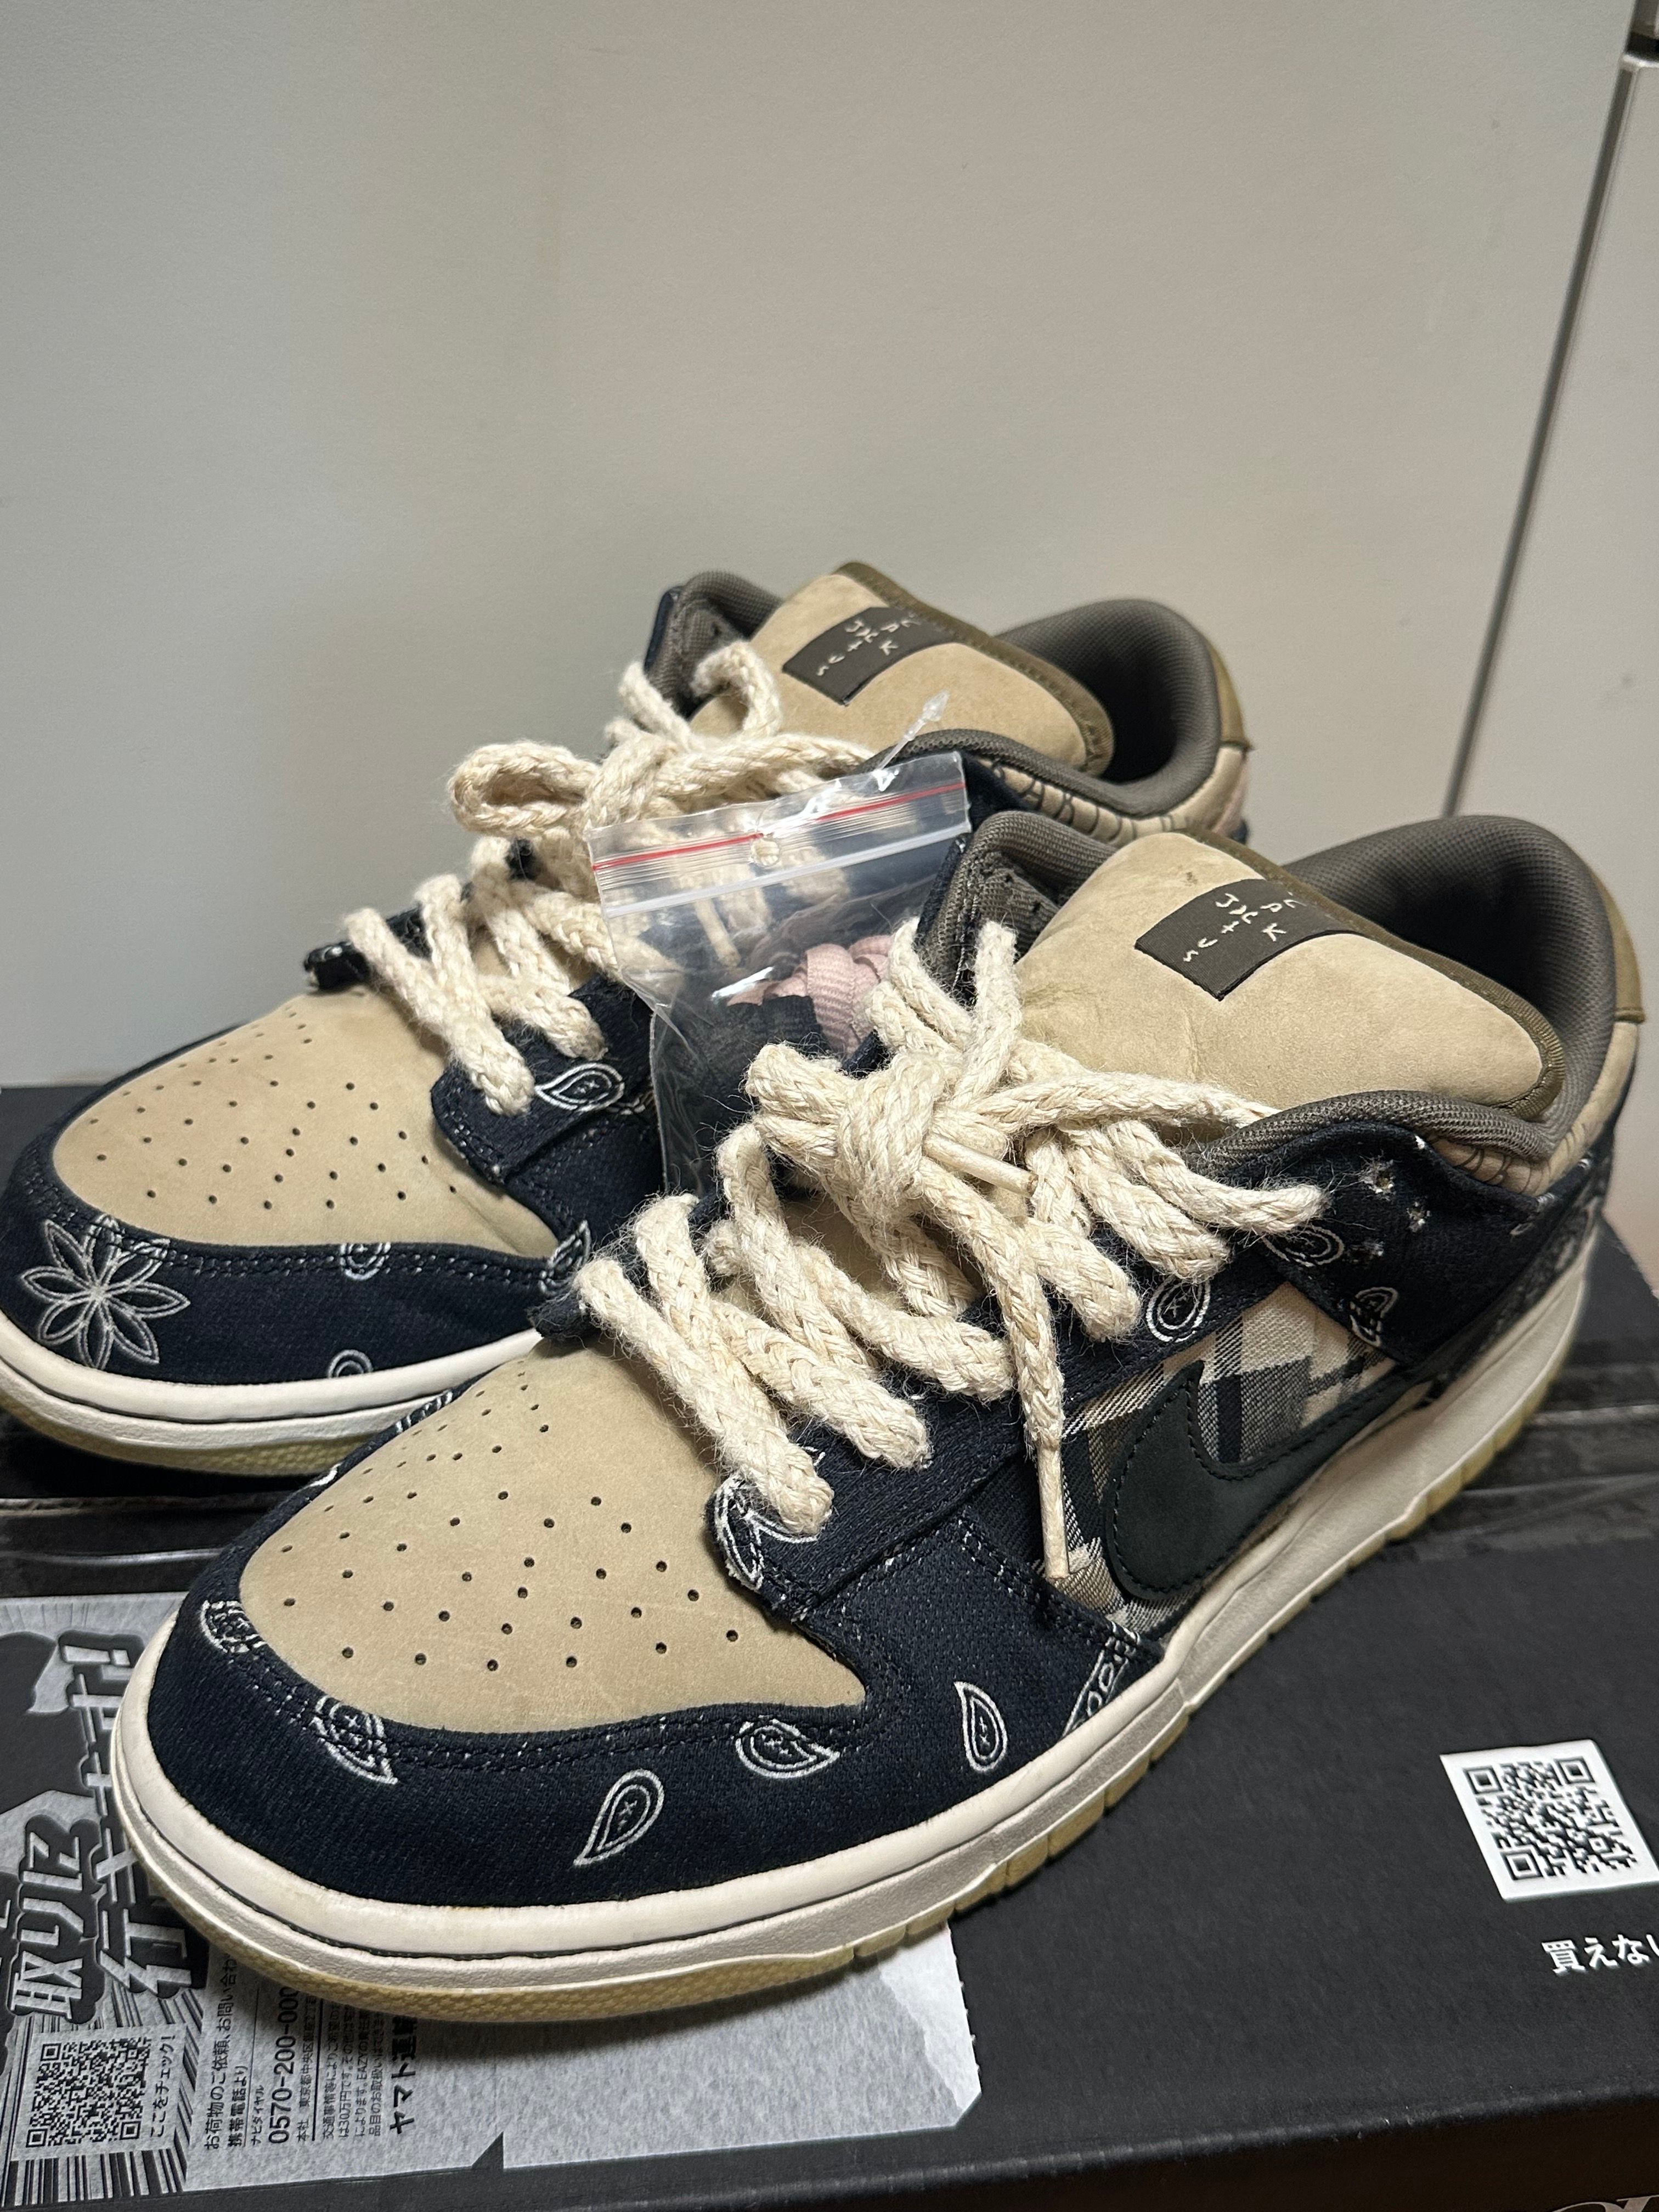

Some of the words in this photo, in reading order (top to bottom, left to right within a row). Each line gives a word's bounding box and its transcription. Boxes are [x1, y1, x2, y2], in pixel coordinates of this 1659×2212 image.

[10, 1831, 83, 2020] 取りに
[150, 2035, 176, 2138] ここをチェック!
[204, 1954, 238, 2149] お荷物のご依頼、お問い合わ
[268, 1987, 300, 2143] 0570-200-000
[228, 2066, 248, 2147] 携帯電話より
[251, 2086, 264, 2145] ナビダイヤル
[297, 2120, 309, 2142] 本社
